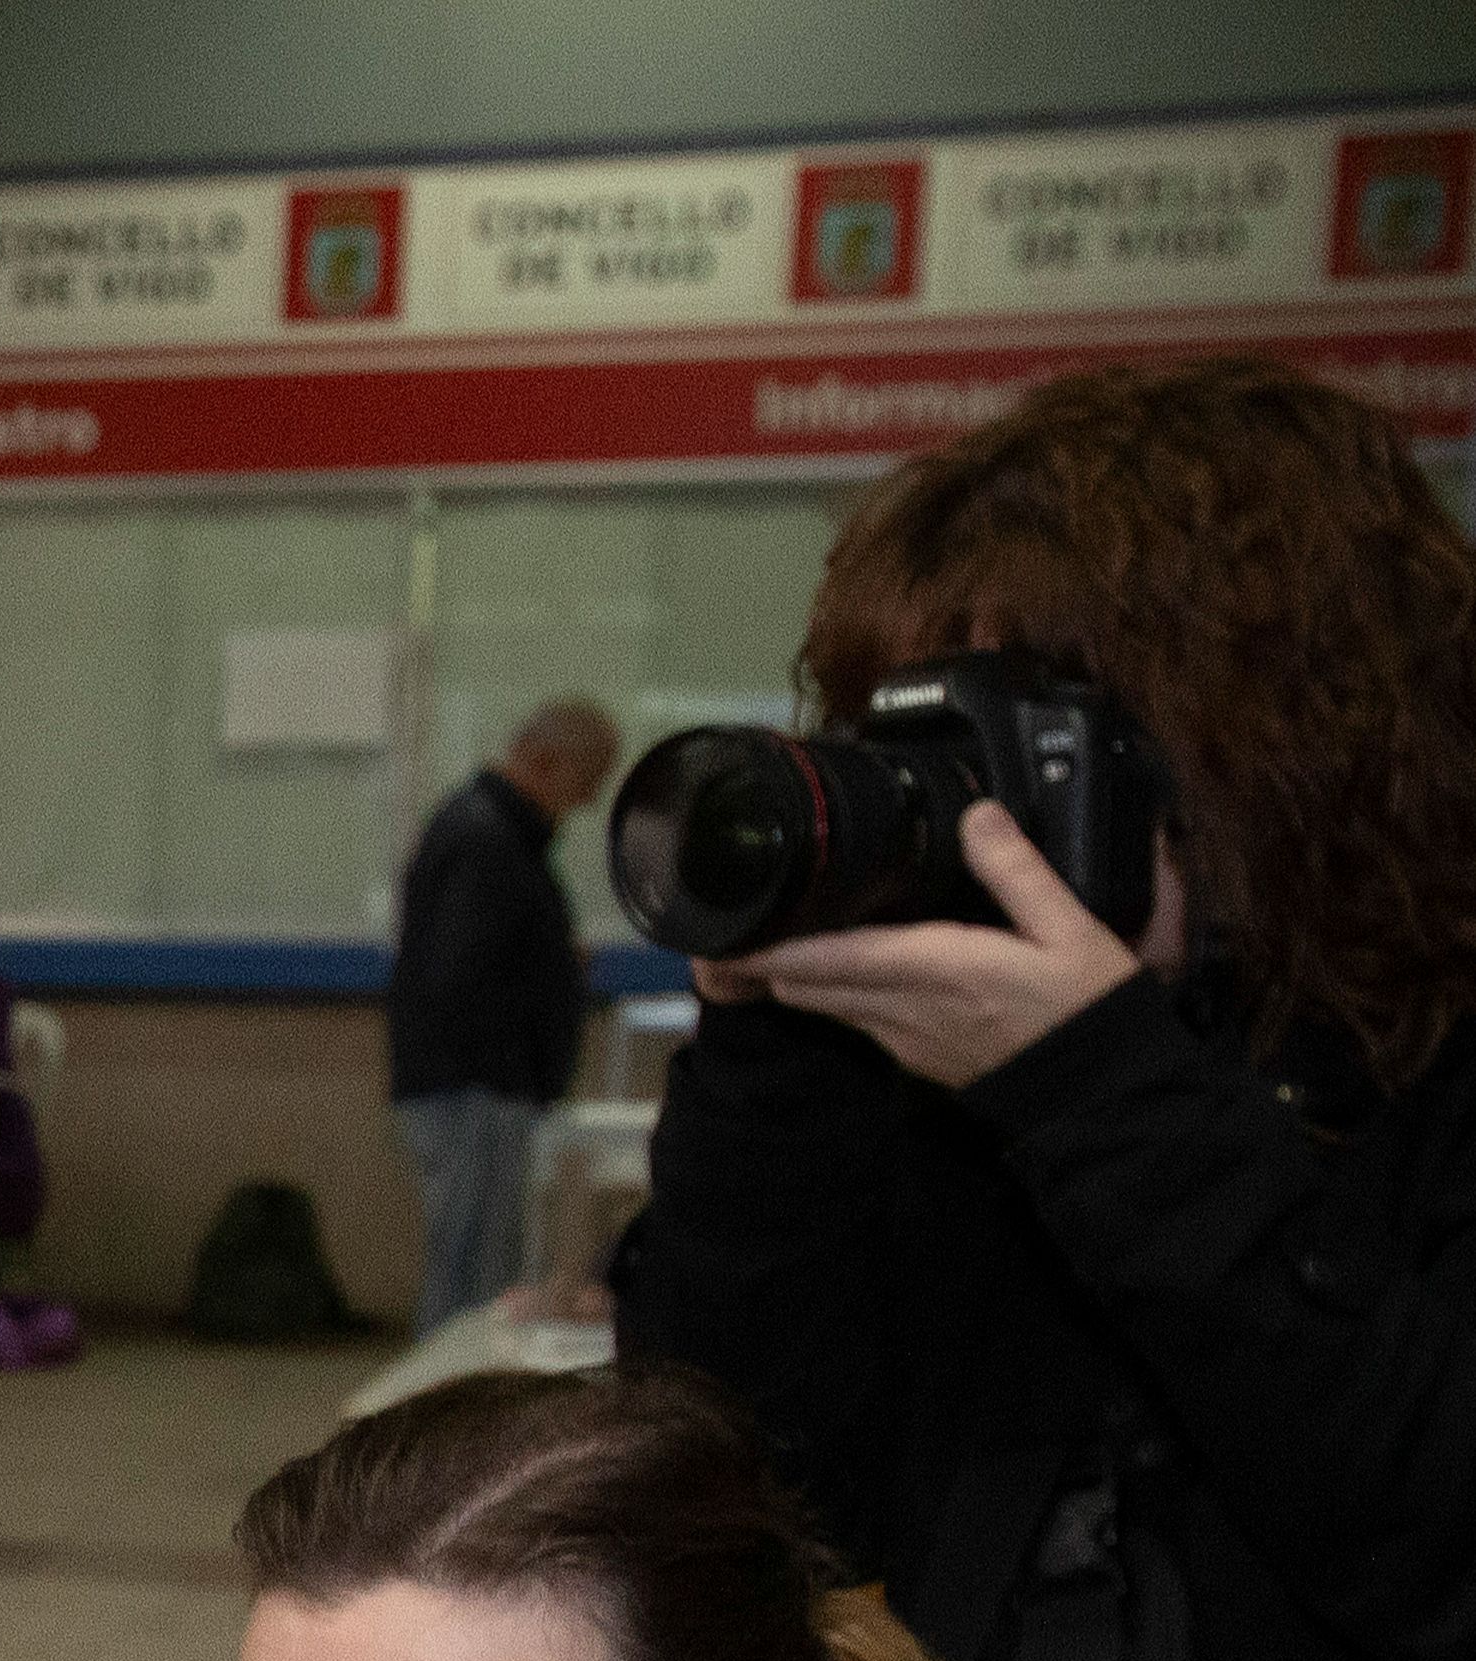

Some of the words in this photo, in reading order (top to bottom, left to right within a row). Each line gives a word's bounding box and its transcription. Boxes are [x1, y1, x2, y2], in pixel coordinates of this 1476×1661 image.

[982, 163, 1288, 223] CONCELLO
[474, 194, 752, 246] CONCELLO
[1012, 226, 1080, 267] DE
[1113, 220, 1249, 261] VIGO
[14, 267, 64, 311] DE
[97, 263, 212, 306] VIGO
[502, 250, 562, 292] DE
[591, 244, 718, 287] VIGO
